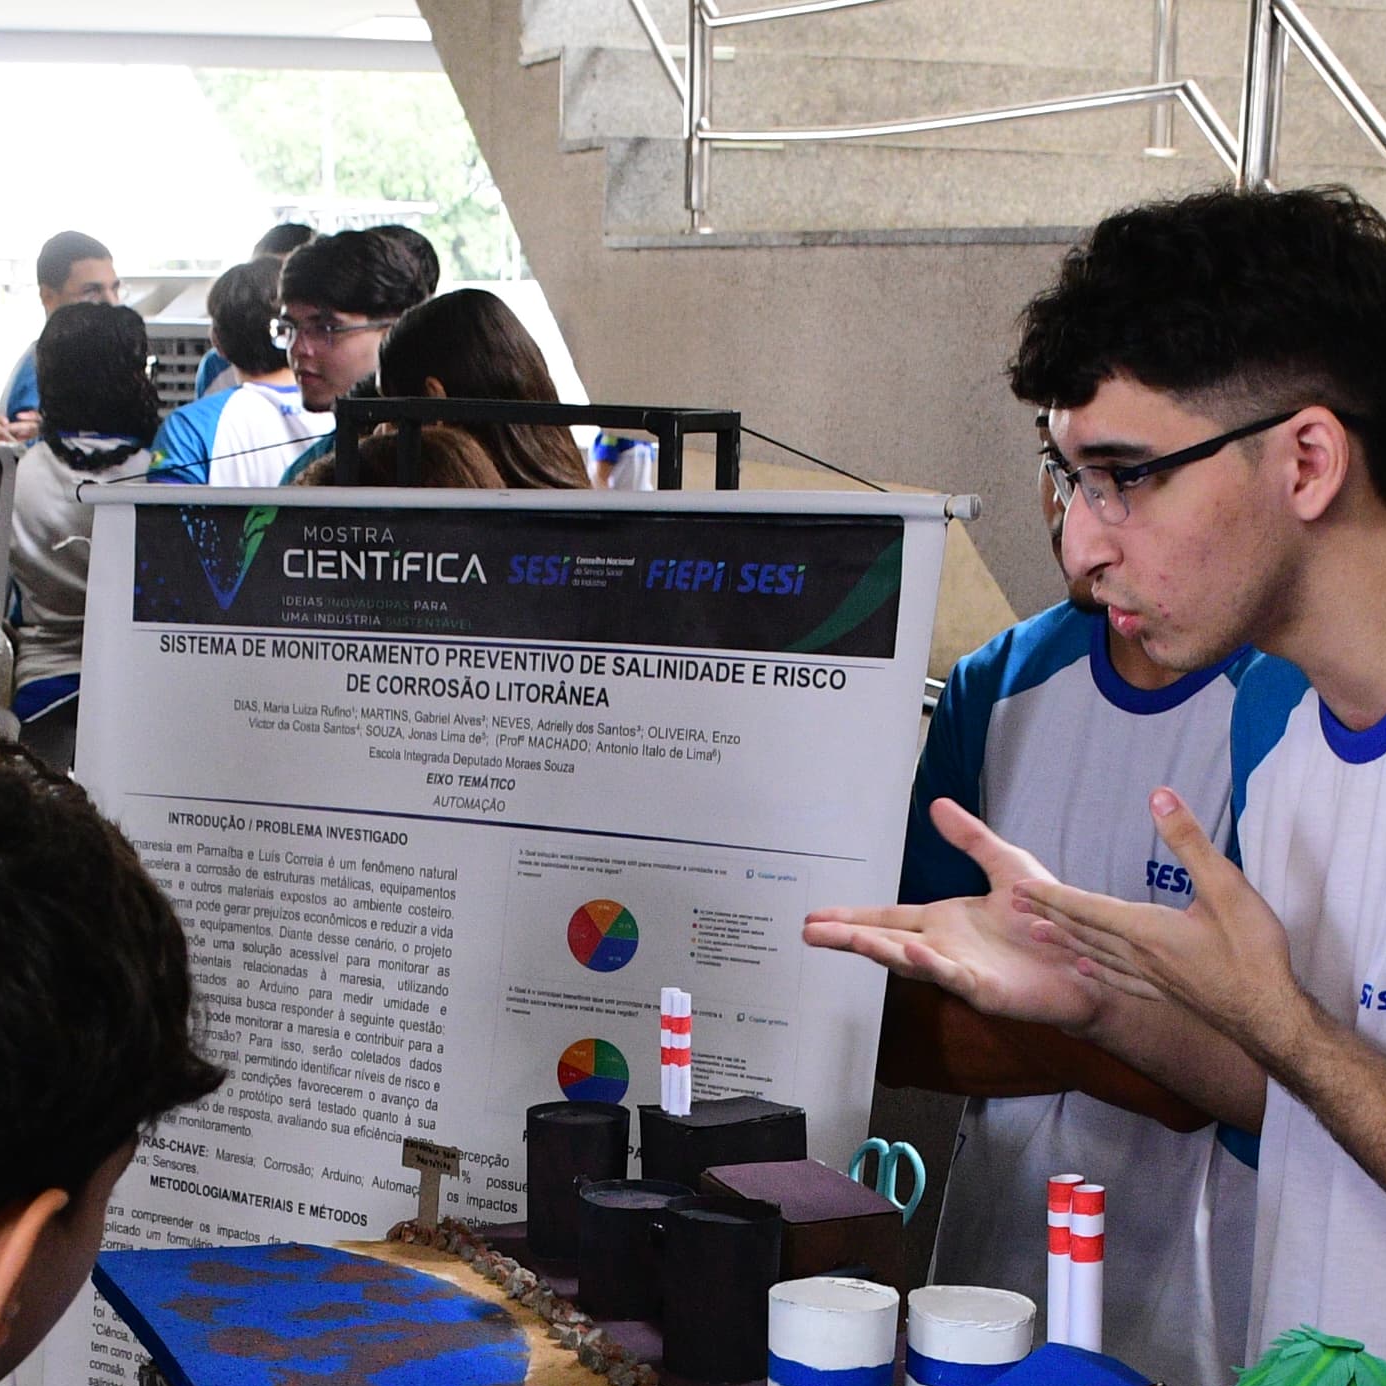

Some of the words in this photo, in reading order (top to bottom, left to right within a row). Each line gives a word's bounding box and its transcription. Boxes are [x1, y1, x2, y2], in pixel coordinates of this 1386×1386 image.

[303, 526, 396, 544] MOSTRA
[282, 549, 488, 585] CIENTÍFICA
[281, 596, 323, 607] IDEIAS
[413, 600, 448, 612] PARA
[281, 612, 310, 623] UMA
[159, 634, 237, 654] SISTEMA
[242, 638, 266, 657] DE
[271, 640, 439, 665] MONITORAMENTO
[445, 648, 574, 672] PREVENTIVO
[579, 654, 605, 675] DE
[611, 656, 745, 683] SALINIDADE
[752, 664, 766, 685] E
[773, 665, 846, 689] RISCO
[346, 673, 370, 692] DE
[376, 675, 490, 699] CORROSÃO
[495, 681, 609, 706] LITORÂNEA
[233, 699, 260, 712] DIAS,
[292, 703, 318, 715] Luiza
[360, 707, 411, 722] MARTINS,
[414, 710, 450, 724] Gabriel
[491, 715, 533, 730] NEVES,
[536, 719, 574, 735] Adrielly
[575, 721, 594, 734] dos
[647, 726, 708, 742] OLIVEIRA,
[711, 730, 741, 744] Enzo
[248, 717, 275, 729] Victor
[277, 719, 290, 730] da
[292, 719, 320, 732] Costa
[365, 724, 405, 739] SOUZA,
[407, 727, 438, 740] Jonas
[440, 729, 466, 742] Lima
[527, 735, 591, 752] MACHADO;
[595, 740, 639, 755] Antonio
[641, 743, 666, 757] Italo
[668, 746, 683, 758] de
[368, 746, 401, 760] Escola
[403, 749, 450, 764] Integrada
[452, 752, 503, 767] Deputado
[504, 756, 541, 770] Moraes
[543, 759, 575, 773] Souza
[426, 772, 454, 785] EIXO
[458, 774, 516, 790] TEMÁTICO
[432, 795, 506, 812] AUTOMAÇÃO
[168, 812, 245, 830] INTRODUÇÃO
[255, 819, 323, 837] PROBLEMA
[326, 826, 408, 845] INVESTIGADO
[176, 843, 192, 853] em
[247, 850, 254, 860] e
[284, 851, 323, 867] Correia
[327, 855, 335, 868] é
[339, 859, 356, 870] um
[361, 858, 415, 876] fenômeno
[419, 866, 458, 880] natural
[184, 862, 191, 872] a
[196, 864, 241, 877] corrosão
[245, 866, 259, 879] de
[263, 870, 315, 884] estruturas
[320, 876, 374, 892] metálicas,
[379, 882, 456, 899] equipamentos
[206, 1008, 231, 1024] pode
[235, 1015, 283, 1030] monitorar
[286, 1022, 293, 1032] a
[297, 1024, 340, 1038] maresia
[343, 1030, 351, 1040] e
[354, 1032, 405, 1047] contribuir
[407, 1039, 432, 1052] para
[436, 1043, 444, 1054] a
[241, 1071, 292, 1087] condições
[297, 1077, 363, 1098] favorecerem
[368, 1090, 376, 1101] o
[380, 1093, 420, 1109] avanço
[424, 1097, 438, 1111] da
[178, 1116, 253, 1136] monitoramento.
[238, 1089, 283, 1105] protótipo
[288, 1097, 311, 1109] será
[317, 1100, 357, 1116] testado
[362, 1109, 399, 1123] quanto
[404, 1112, 411, 1126] à
[417, 1118, 436, 1130] sua
[152, 1154, 199, 1173] Sensores.
[215, 1147, 256, 1167] Maresia;
[263, 1156, 314, 1176] Corrosão;
[320, 1167, 364, 1186] Arduino;
[149, 1175, 293, 1212] METODOLOGIA/MATERIAIS
[297, 1202, 306, 1215] E
[309, 1204, 368, 1226] MÉTODOS
[447, 1191, 459, 1204] os
[466, 1192, 518, 1213] impactos
[93, 1306, 105, 1319] foi
[90, 1341, 108, 1354] tem
[110, 1347, 132, 1361] como
